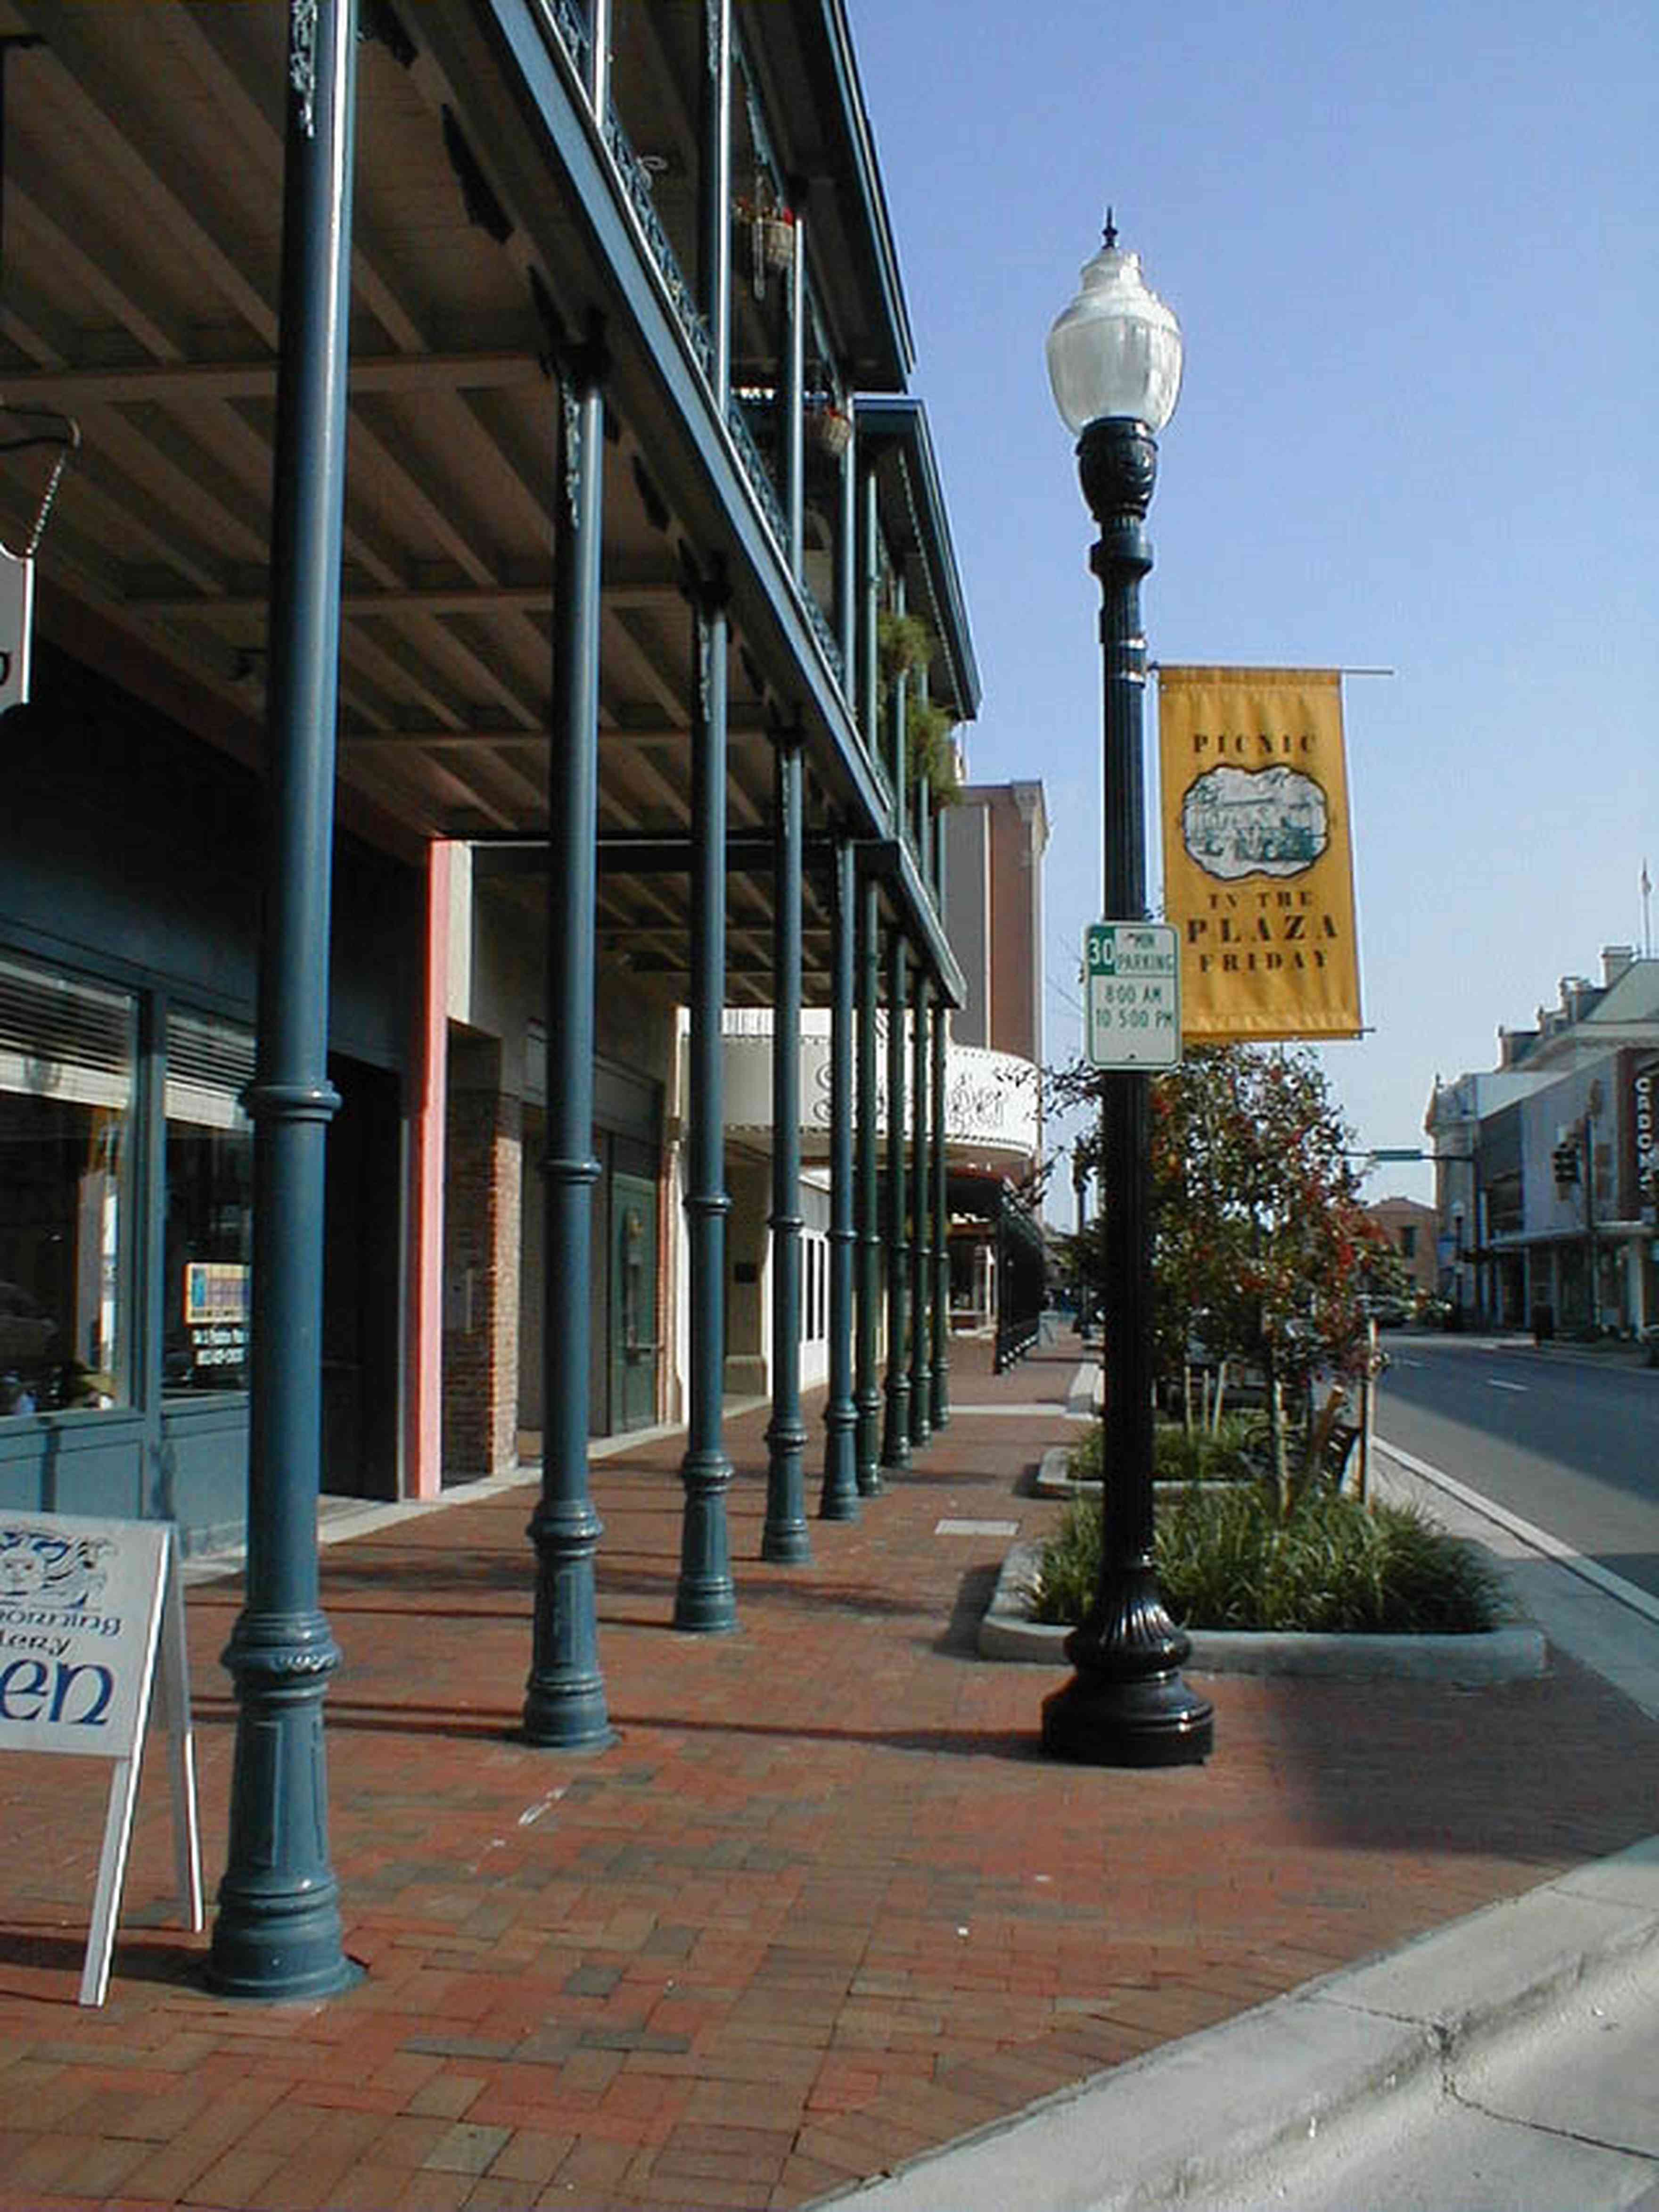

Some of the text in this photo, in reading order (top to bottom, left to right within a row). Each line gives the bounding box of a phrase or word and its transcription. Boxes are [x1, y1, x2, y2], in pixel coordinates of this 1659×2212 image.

[1192, 734, 1316, 754] PICNIC
[1209, 891, 1312, 909] IN THE
[1188, 914, 1338, 943] PLAZA
[1089, 936, 1114, 966] 30
[1199, 949, 1328, 973] FRIDAY
[1117, 954, 1174, 971] PARKING
[1142, 984, 1163, 1004] AM
[1155, 1009, 1174, 1028] PM
